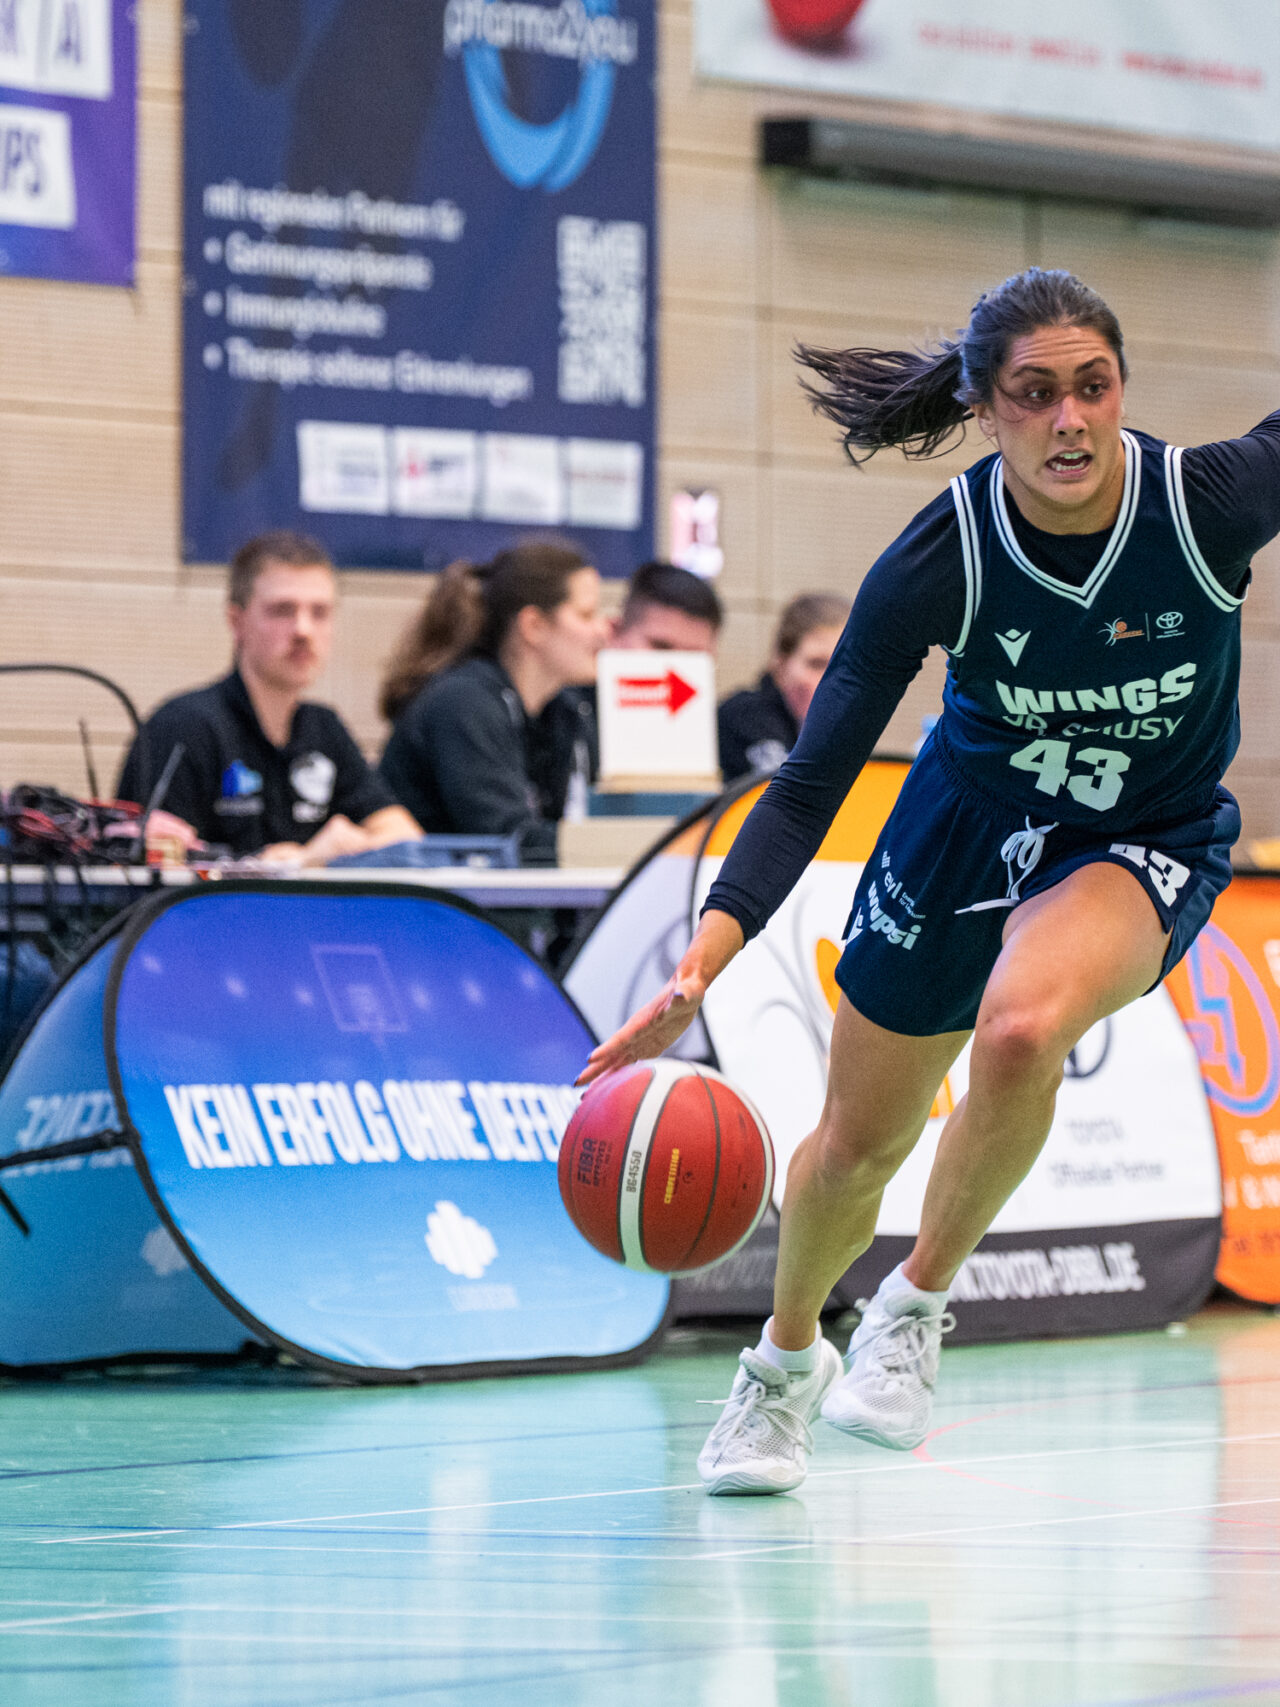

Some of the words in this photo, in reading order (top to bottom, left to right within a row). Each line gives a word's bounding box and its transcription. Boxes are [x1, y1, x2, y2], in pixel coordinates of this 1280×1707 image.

[995, 662, 1197, 715] WINGS
[1009, 738, 1132, 812] 43
[1108, 843, 1191, 908] 43
[868, 880, 922, 950] wupsi
[163, 1083, 273, 1169] KEIN
[252, 1080, 400, 1166] ERFOLG
[382, 1079, 491, 1162] OHNE
[577, 1138, 597, 1186] FIBA
[625, 1150, 642, 1193] BG4550
